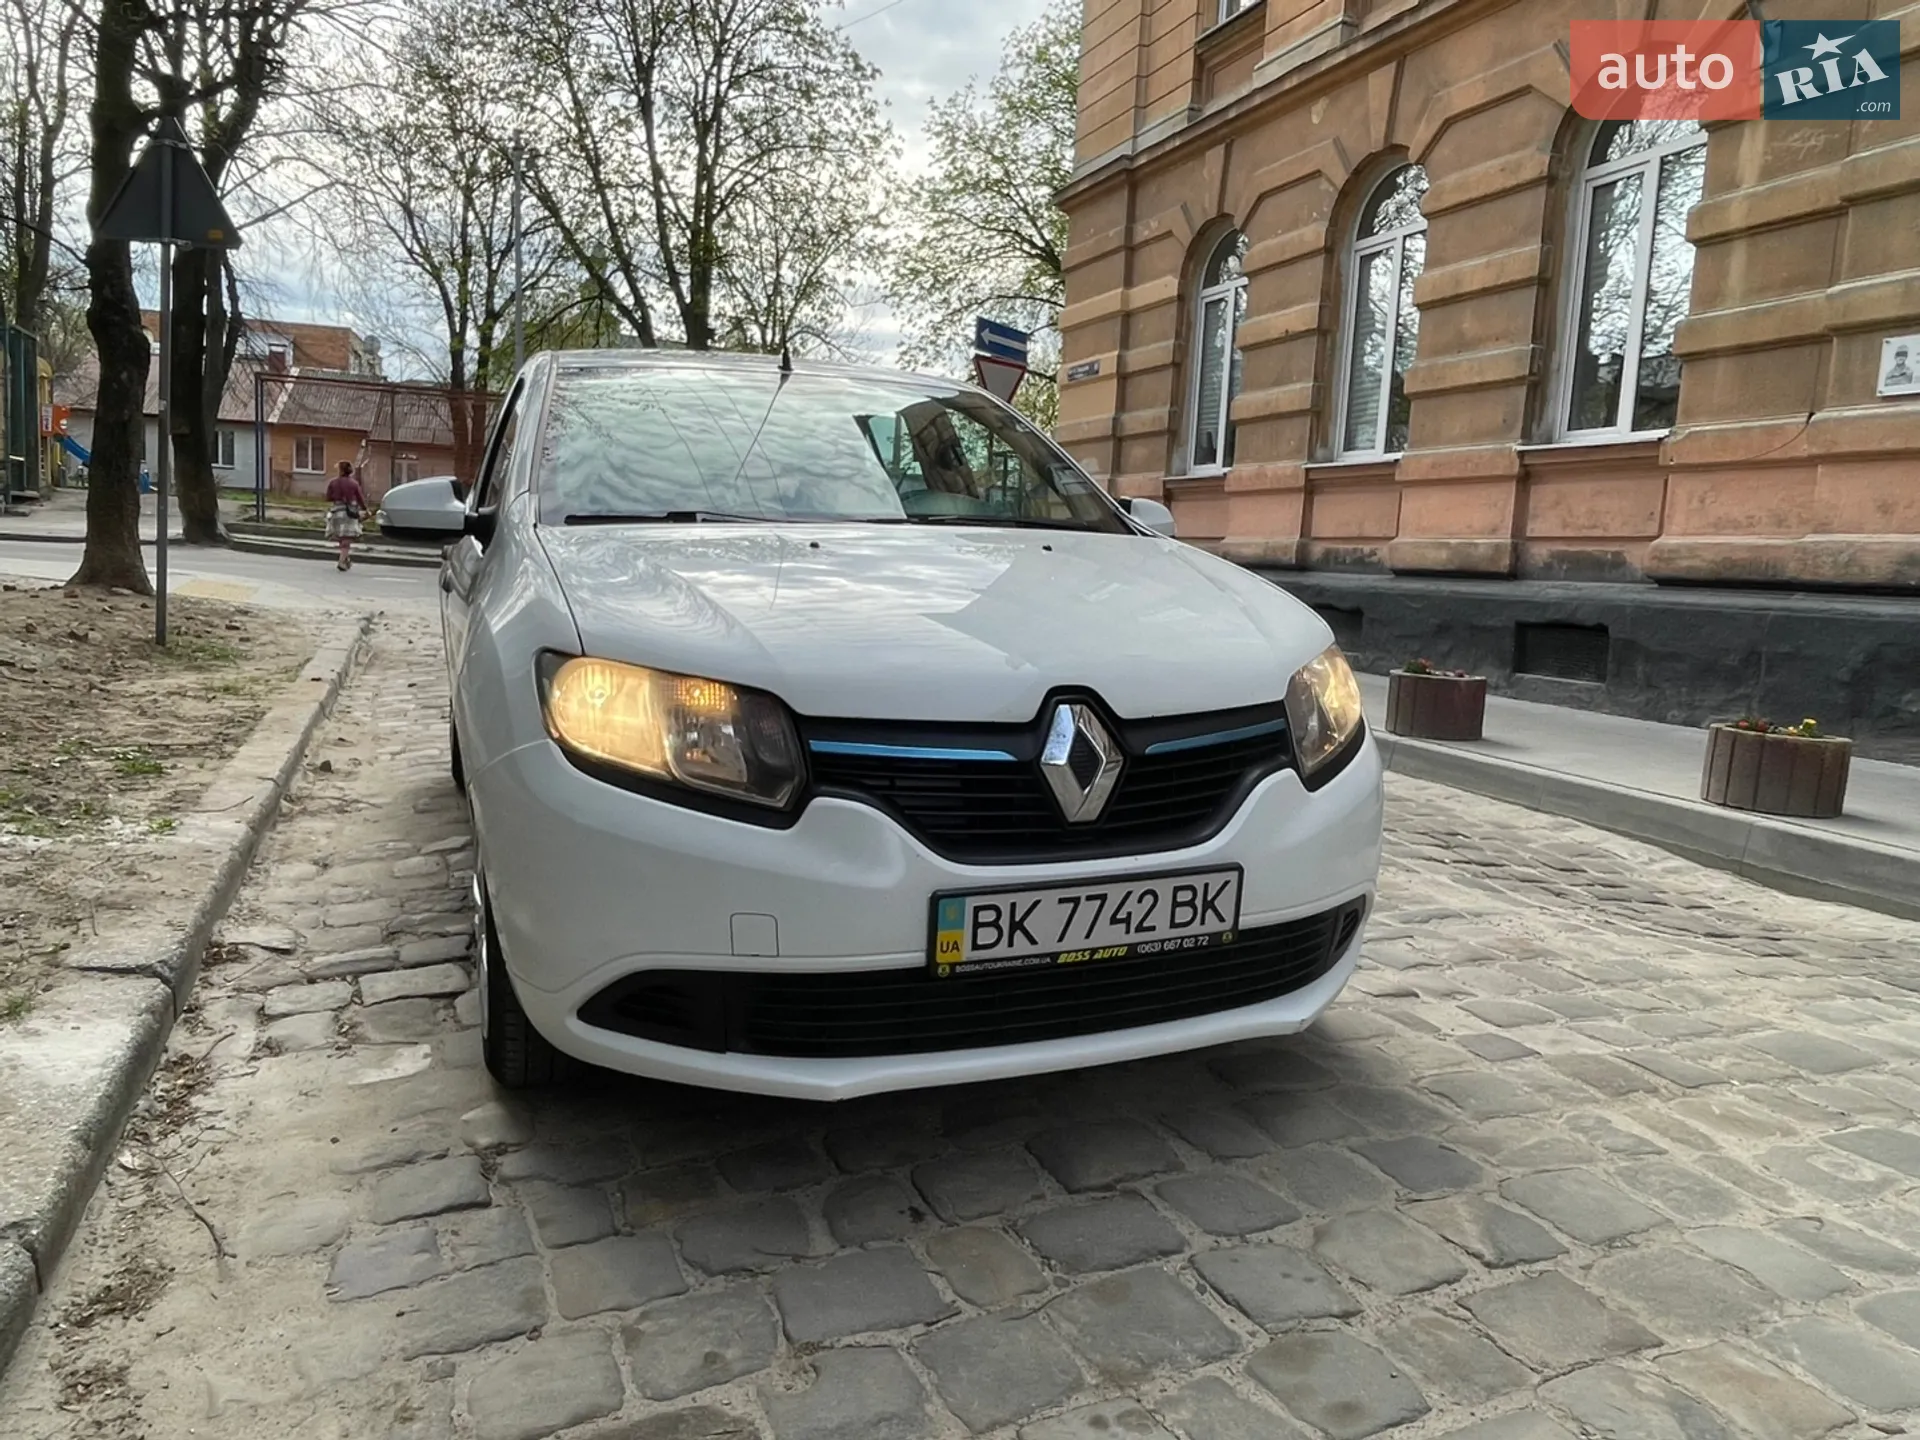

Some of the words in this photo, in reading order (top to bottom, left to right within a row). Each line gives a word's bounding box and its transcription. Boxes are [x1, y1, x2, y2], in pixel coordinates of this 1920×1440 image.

[971, 899, 1041, 951] BK
[1057, 889, 1158, 943] 7742
[1169, 880, 1231, 929] BK
[940, 940, 960, 953] UA
[1137, 943, 1161, 953] (063)
[1183, 936, 1196, 948] 02
[1197, 936, 1209, 945] 72
[1057, 952, 1090, 963] BOSS
[1093, 946, 1128, 958] AUTO
